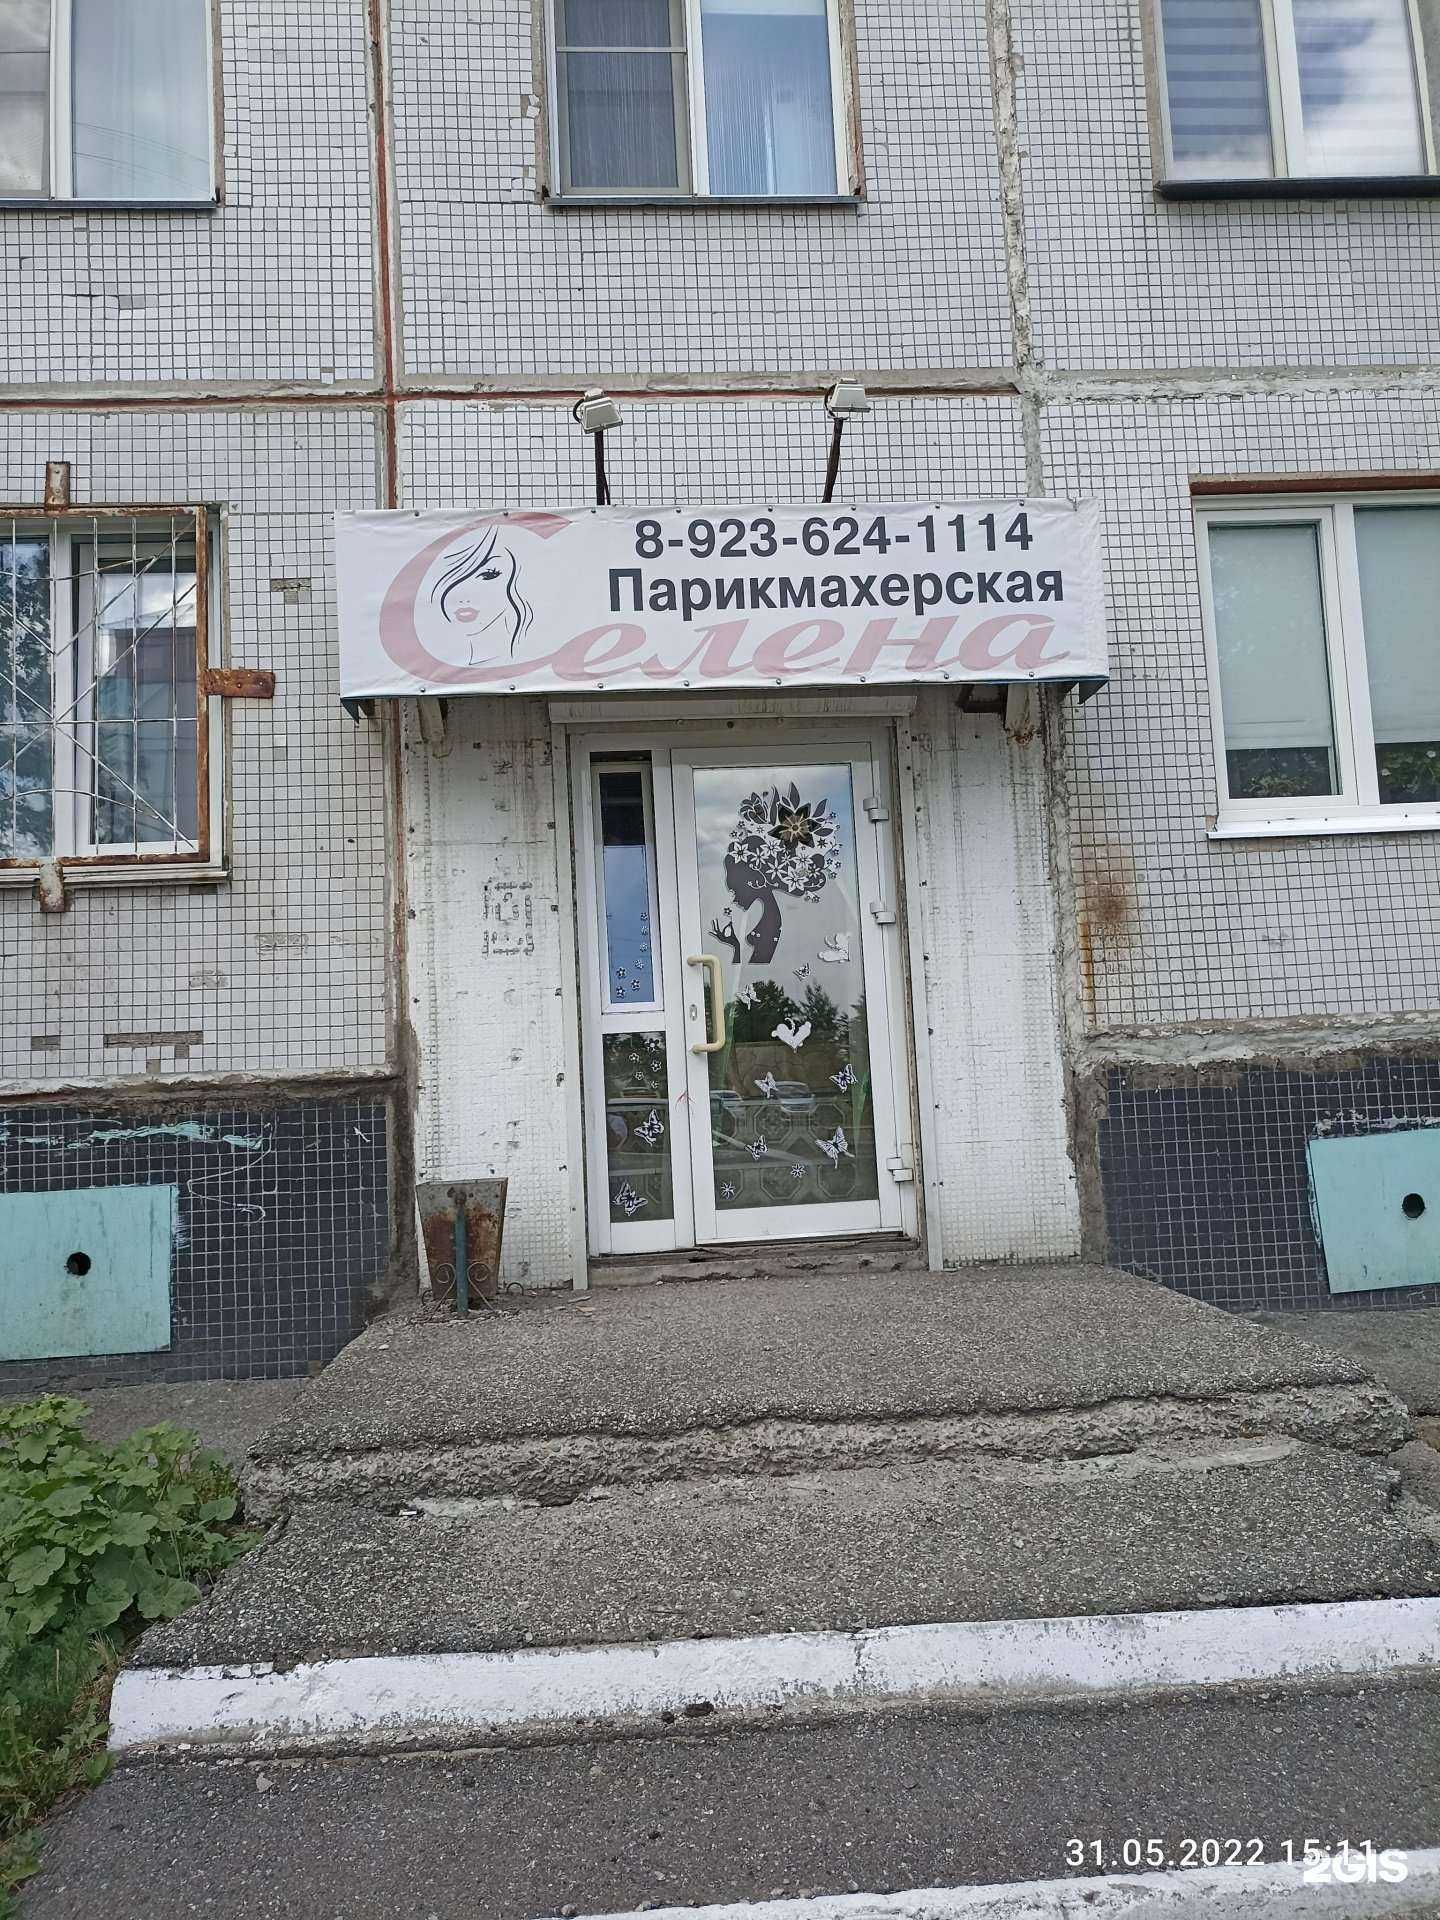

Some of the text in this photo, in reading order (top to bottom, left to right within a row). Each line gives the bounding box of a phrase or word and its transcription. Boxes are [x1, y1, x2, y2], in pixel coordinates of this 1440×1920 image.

[634, 512, 1034, 559] 8-923-624-1114
[378, 511, 1071, 682] Селена
[608, 566, 1064, 620] Парикмахерская
